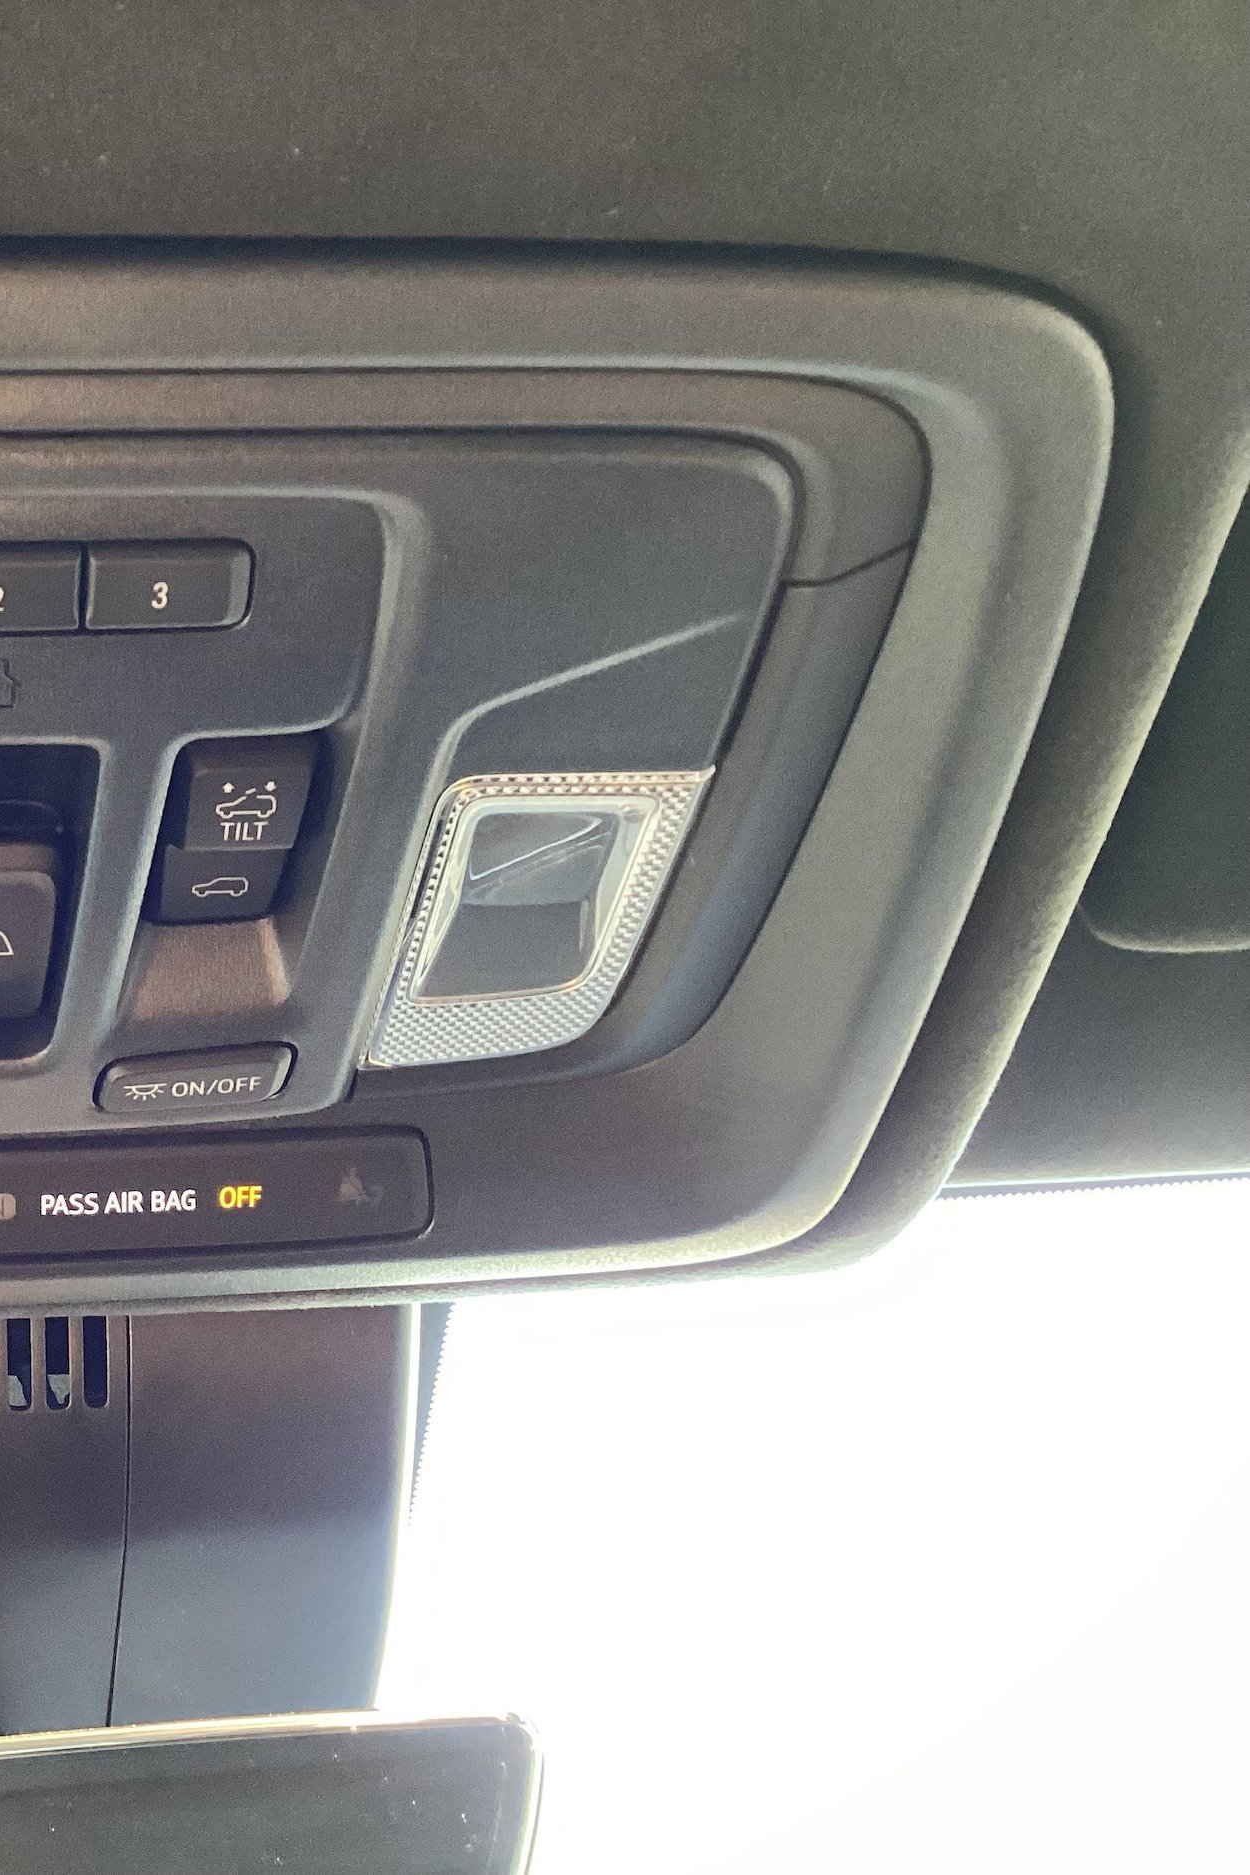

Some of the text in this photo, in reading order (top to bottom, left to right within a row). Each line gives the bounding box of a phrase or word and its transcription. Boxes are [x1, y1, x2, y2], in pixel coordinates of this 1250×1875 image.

[151, 581, 169, 609] 3
[220, 821, 269, 841] TILT
[171, 1076, 263, 1098] ON/OFF
[40, 1193, 99, 1216] PASS
[104, 1191, 144, 1214] AIR
[151, 1189, 197, 1212] BAG
[218, 1185, 262, 1209] OFF
